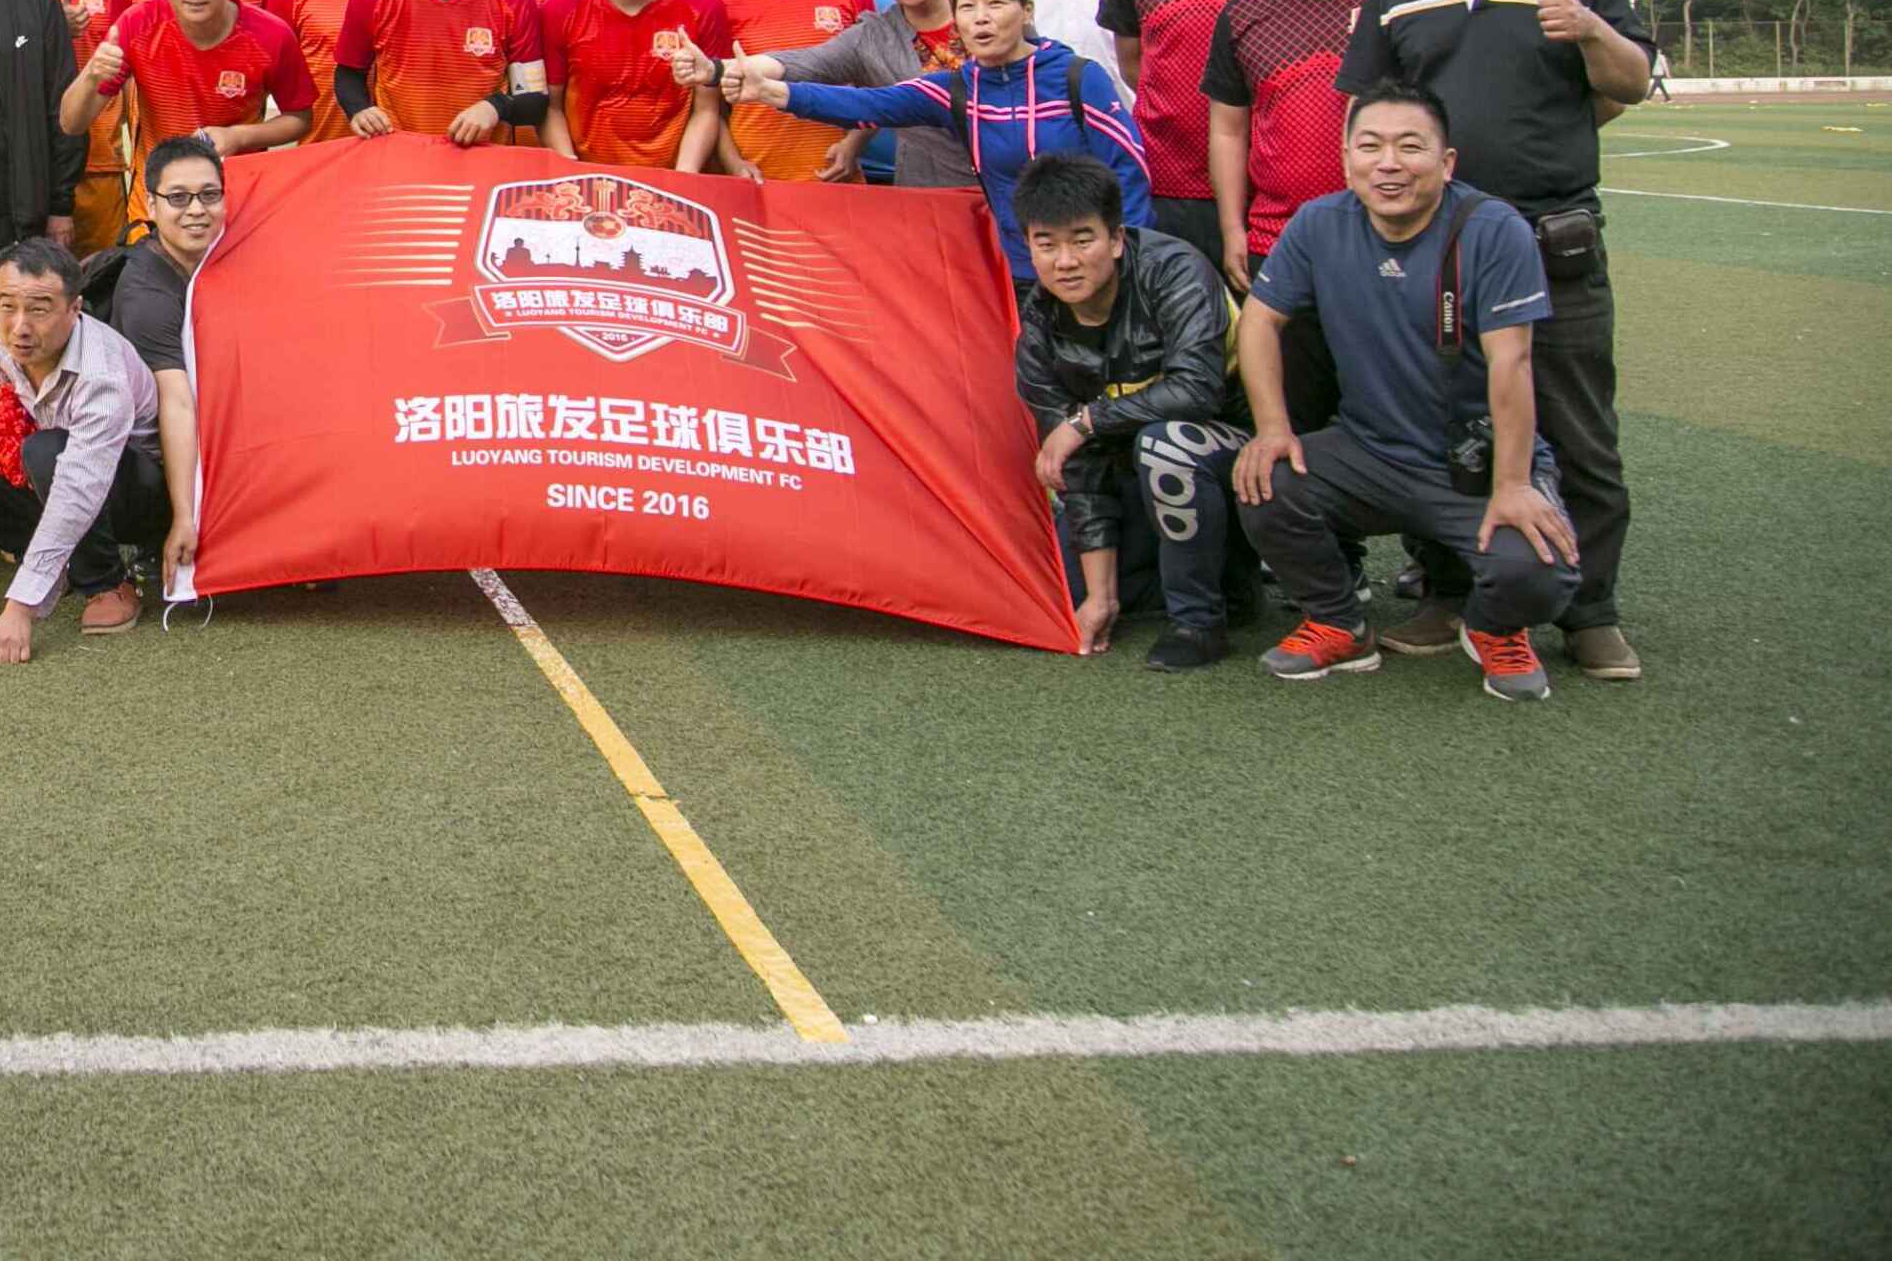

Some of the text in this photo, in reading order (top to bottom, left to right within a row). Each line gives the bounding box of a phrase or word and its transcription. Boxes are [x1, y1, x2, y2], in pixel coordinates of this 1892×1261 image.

[1443, 291, 1455, 333] Canon
[394, 393, 856, 475] 洛阳旅发足球俱乐部
[451, 449, 803, 491] LUOYANG TOURISM DEVELOPMENT FC
[547, 483, 710, 520] SINCE 2016
